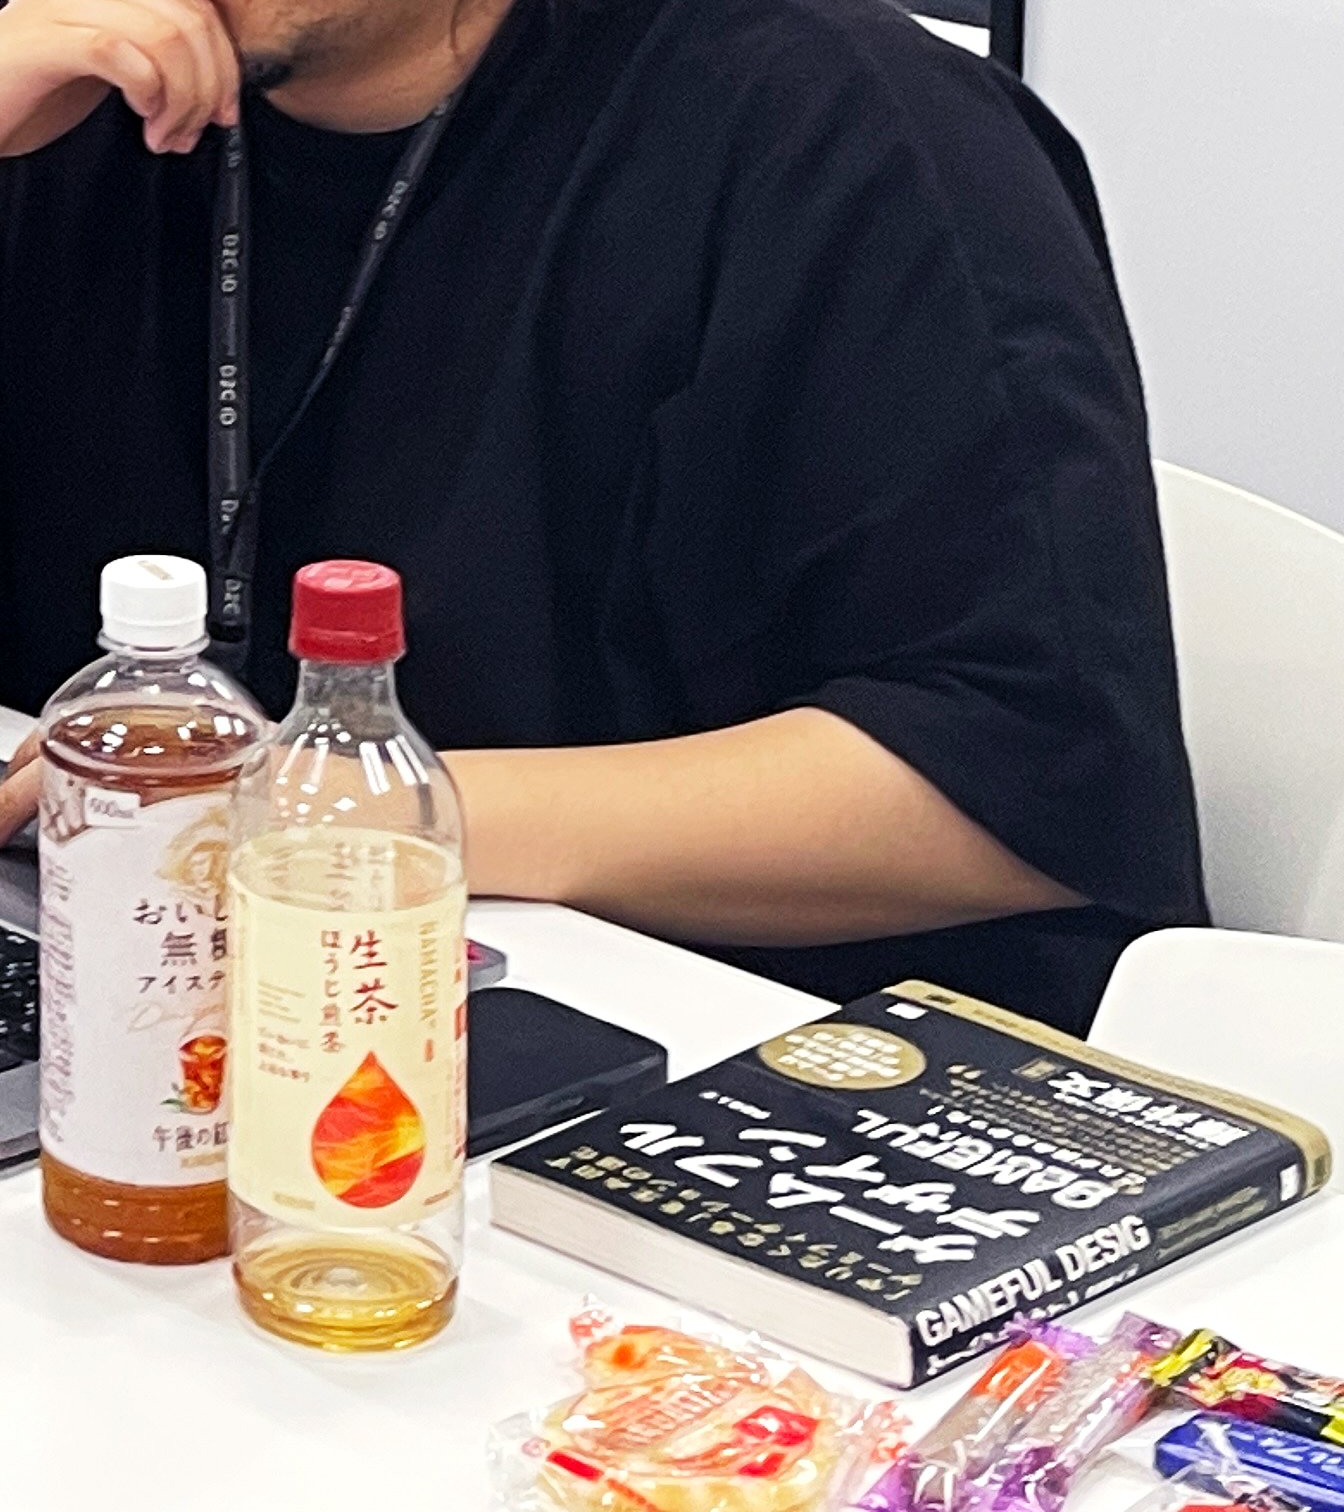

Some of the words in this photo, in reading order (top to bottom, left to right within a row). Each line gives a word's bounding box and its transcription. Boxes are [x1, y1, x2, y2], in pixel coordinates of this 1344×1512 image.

[349, 929, 399, 1025] 生茶
[618, 1121, 979, 1265] ゲームフル
[738, 1127, 1042, 1240] デザイン
[852, 1109, 1106, 1209] GAMEFUL
[916, 1259, 1064, 1346] GAMEFUL
[1055, 1215, 1151, 1281] DESIG
